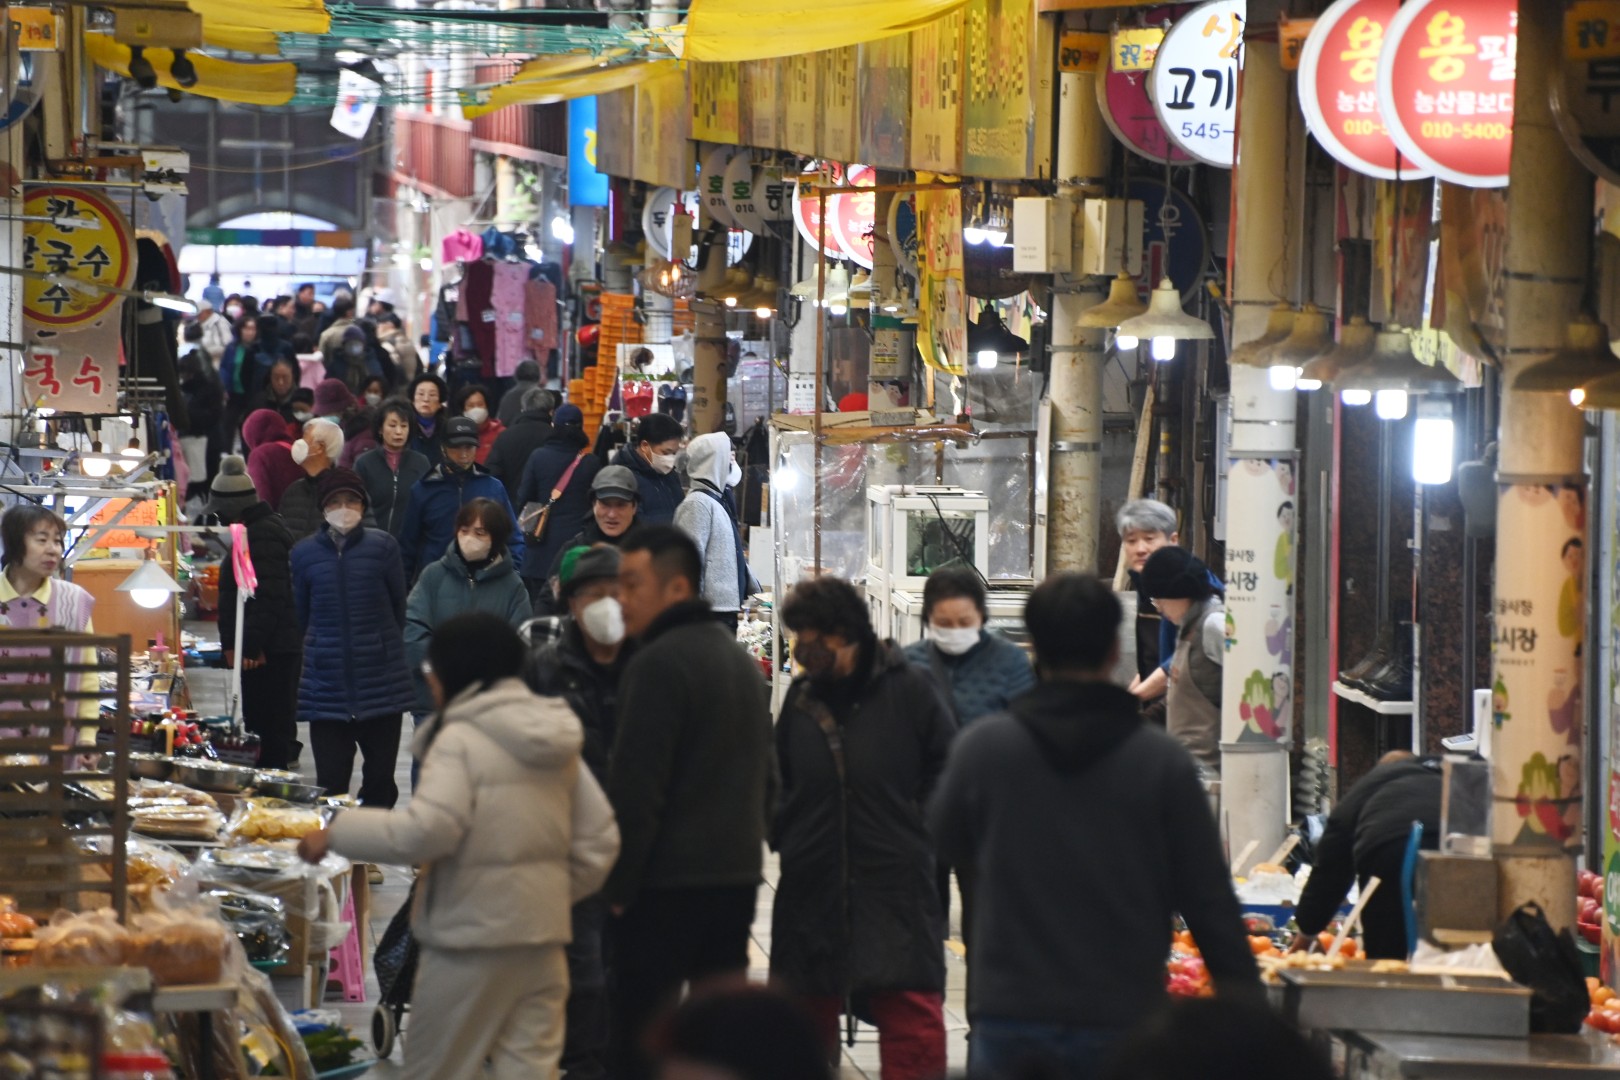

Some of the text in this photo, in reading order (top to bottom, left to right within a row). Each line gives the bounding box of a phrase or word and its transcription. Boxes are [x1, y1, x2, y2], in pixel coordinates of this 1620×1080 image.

[1165, 66, 1234, 110] 고기
[1337, 90, 1379, 113] 농산
[732, 180, 752, 200] 호
[38, 285, 70, 314] 수
[1227, 571, 1259, 592] 시장
[1494, 626, 1539, 653] 시장
